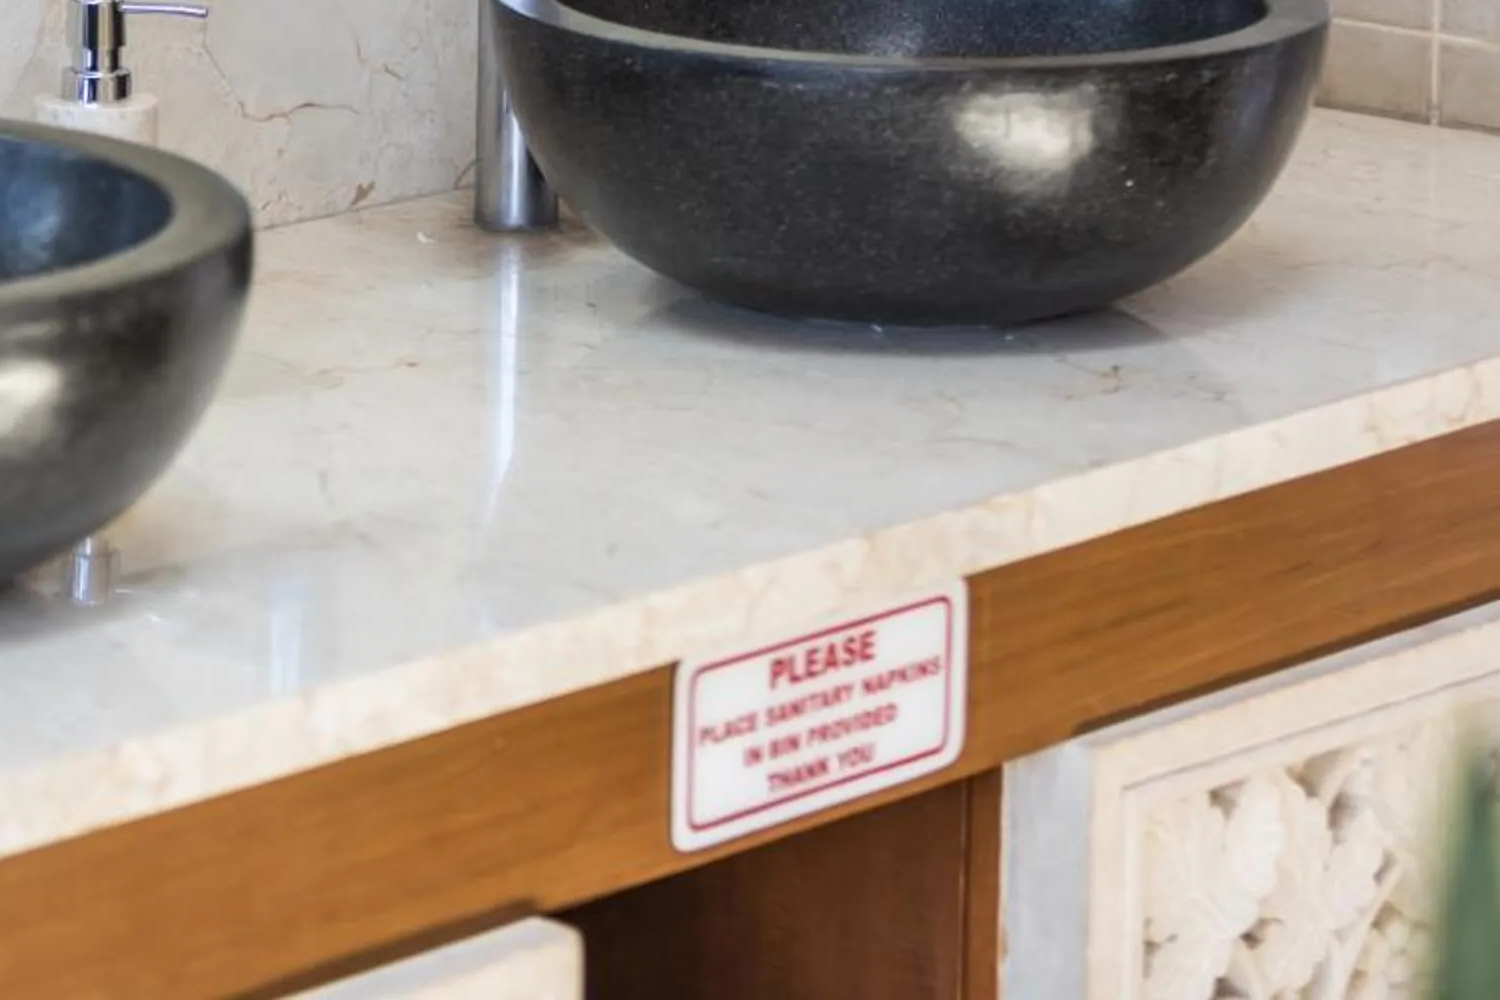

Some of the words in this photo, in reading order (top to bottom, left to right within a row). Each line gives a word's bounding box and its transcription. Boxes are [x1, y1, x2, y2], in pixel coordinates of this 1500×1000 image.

[768, 631, 877, 691] PLEASE
[699, 712, 758, 747] PLACE
[764, 683, 854, 727] SANITARY
[861, 656, 941, 695] NAPKINS
[743, 746, 763, 768] IN
[806, 702, 898, 747] PROVIDED
[766, 757, 829, 791] THANK
[836, 742, 876, 771] YOU
